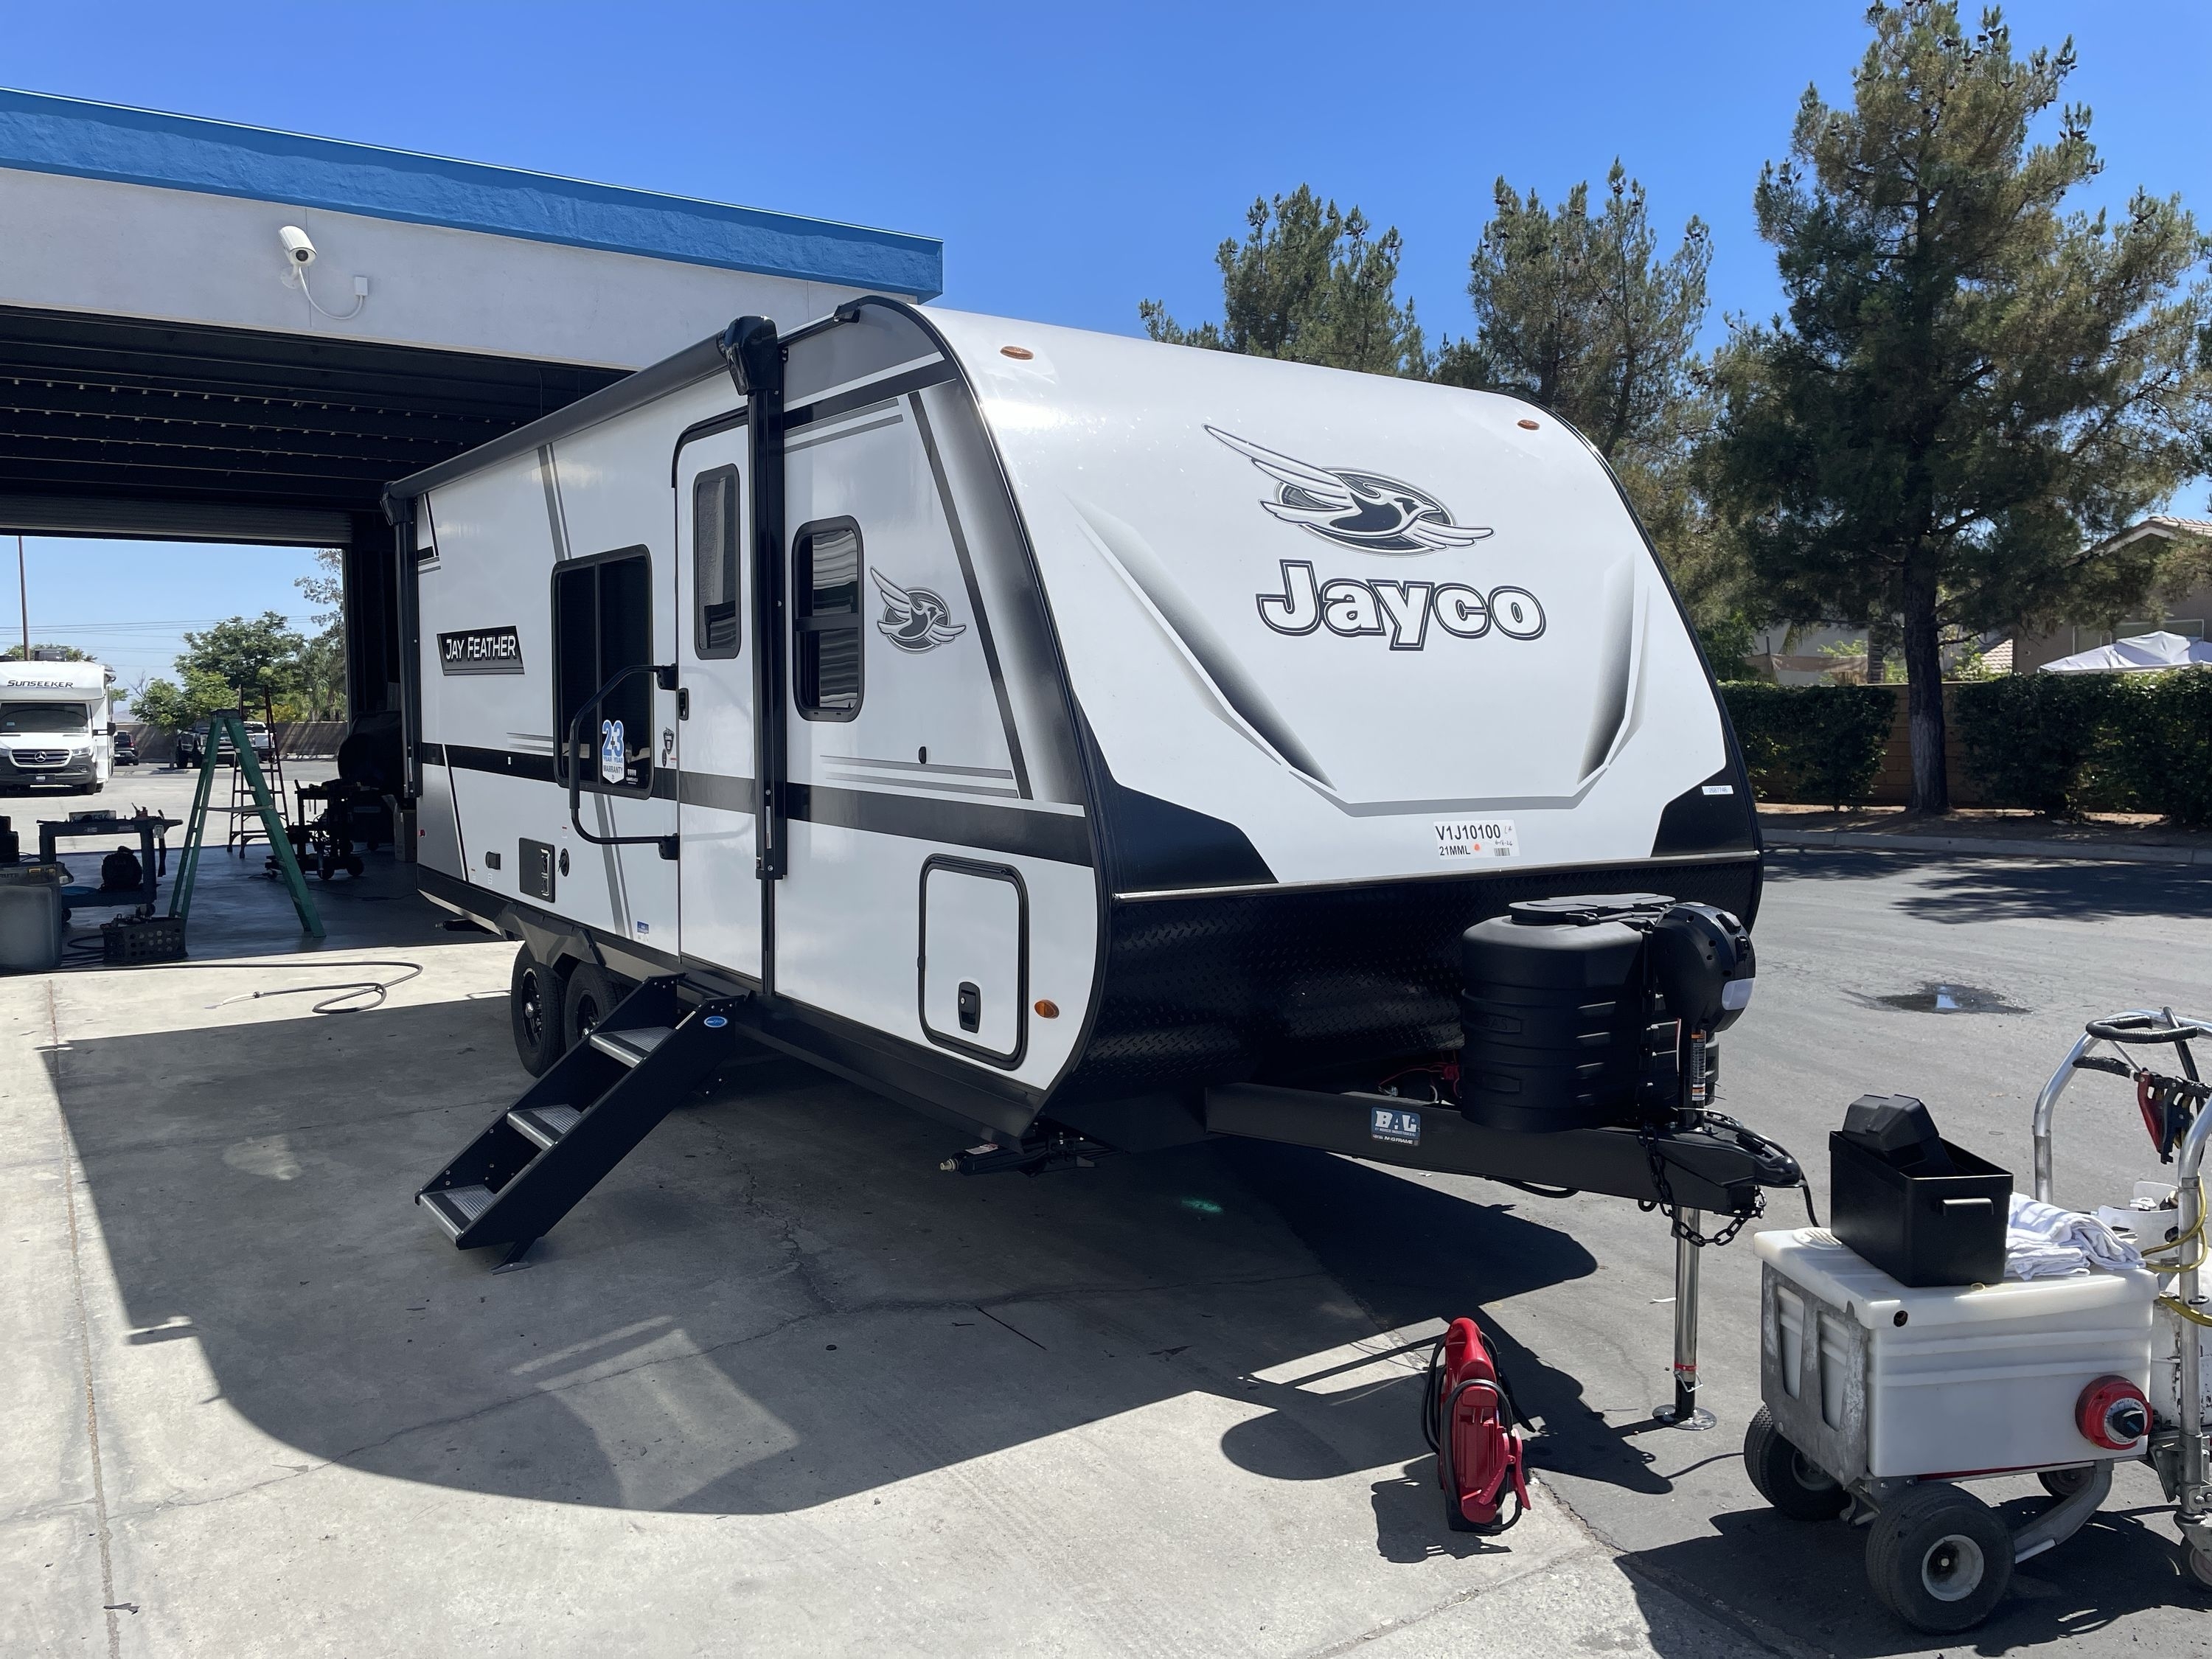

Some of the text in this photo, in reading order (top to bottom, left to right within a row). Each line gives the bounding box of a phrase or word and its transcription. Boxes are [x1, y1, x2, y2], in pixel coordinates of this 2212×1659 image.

[1256, 559, 1547, 651] Jayco
[445, 635, 516, 660] JAY FEATHER
[603, 765, 623, 774] WARRANTY
[1435, 824, 1501, 841] V1J10100
[1439, 845, 1471, 856] 21MML
[1374, 1110, 1417, 1133] BAL
